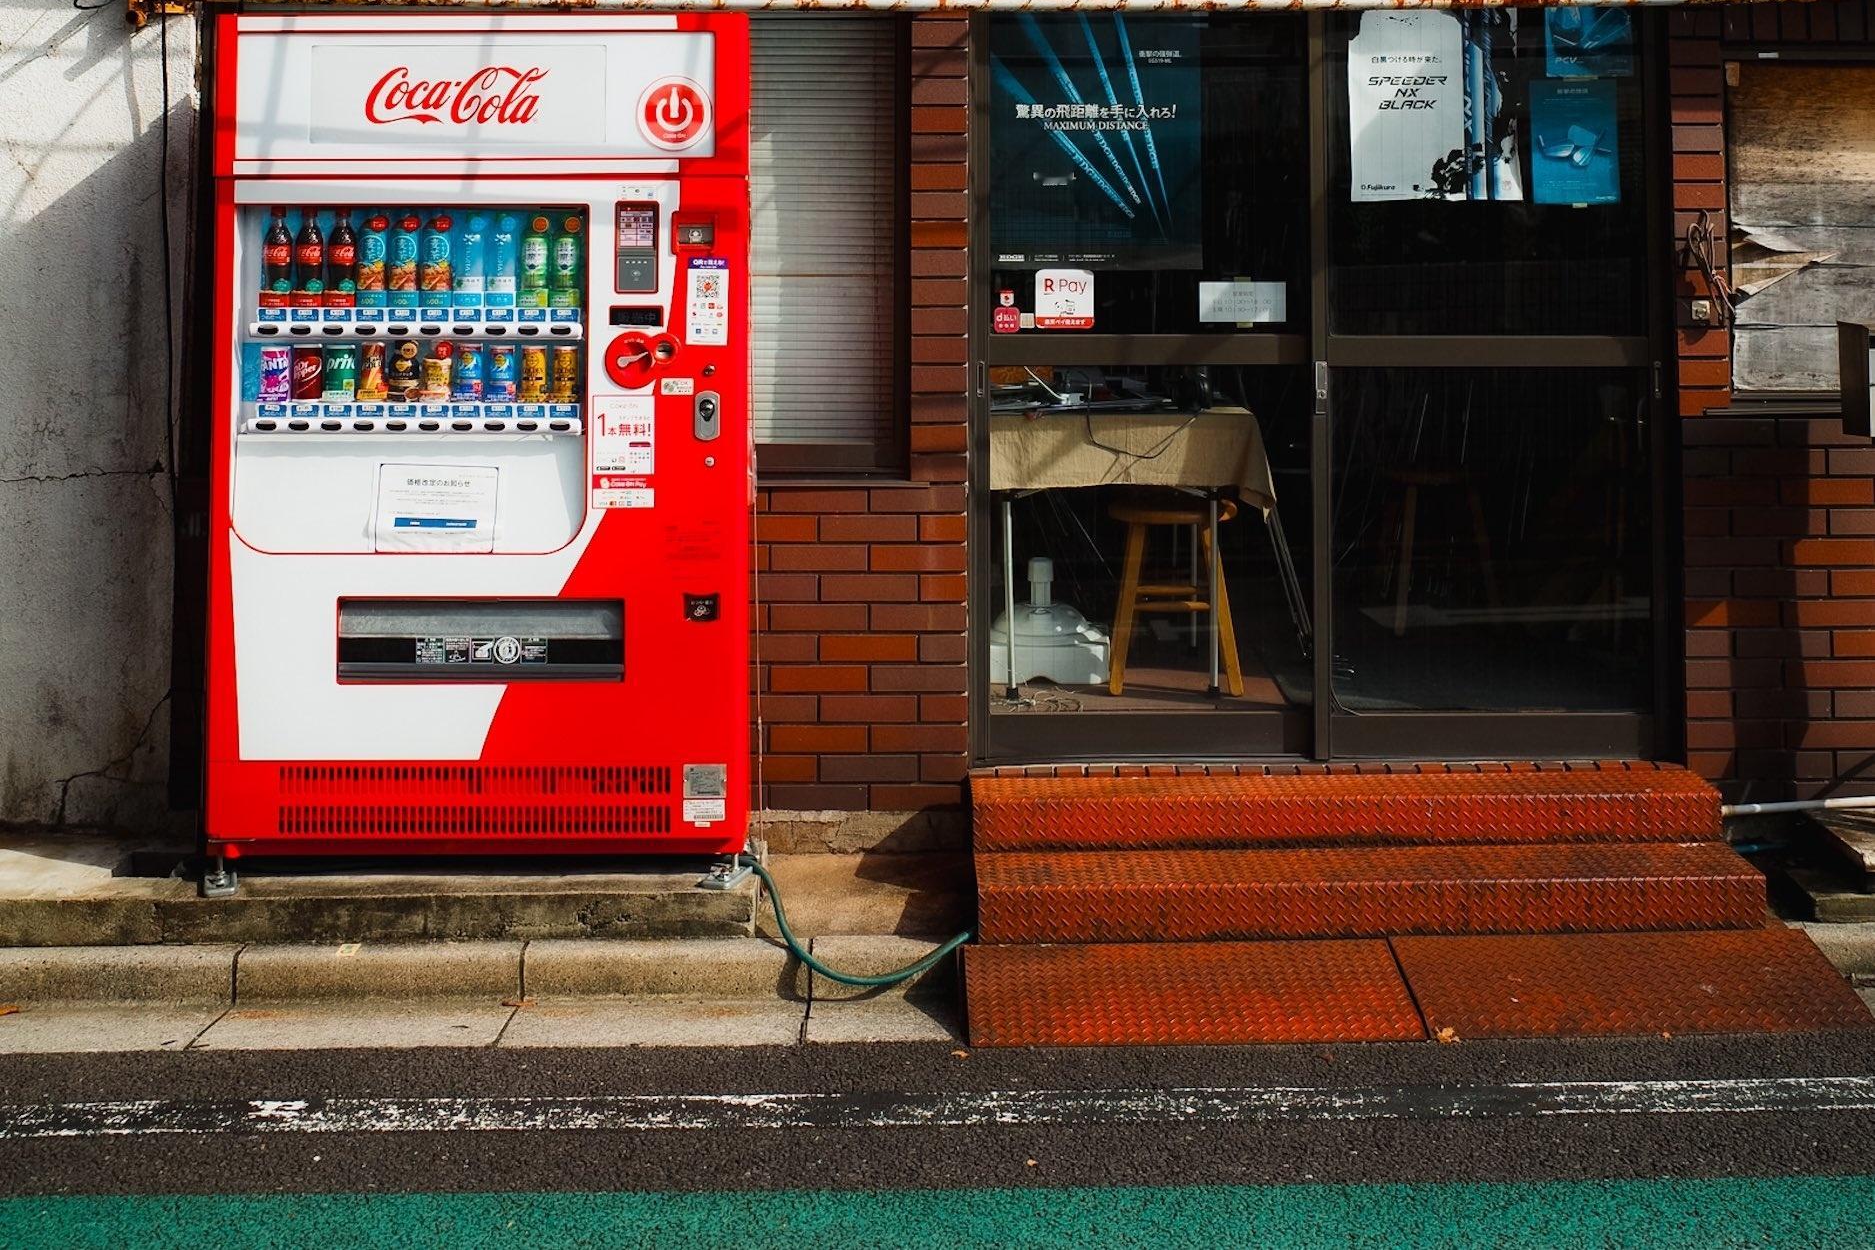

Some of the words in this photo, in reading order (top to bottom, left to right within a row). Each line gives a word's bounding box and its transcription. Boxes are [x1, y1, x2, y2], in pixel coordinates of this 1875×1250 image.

[1368, 76, 1448, 86] SPEEDER
[365, 67, 550, 124] Coca-Cola
[1395, 88, 1421, 98] NX
[1015, 104, 1177, 119] 驚異の飛距離を手に入れろ!
[1379, 100, 1438, 110] BLACK
[1043, 120, 1096, 131] MAXIMUM
[1098, 120, 1149, 131] DISTANCE
[1044, 278, 1055, 292] R
[1059, 279, 1087, 295] Pay
[260, 358, 288, 371] ANTA
[326, 354, 355, 372] prit
